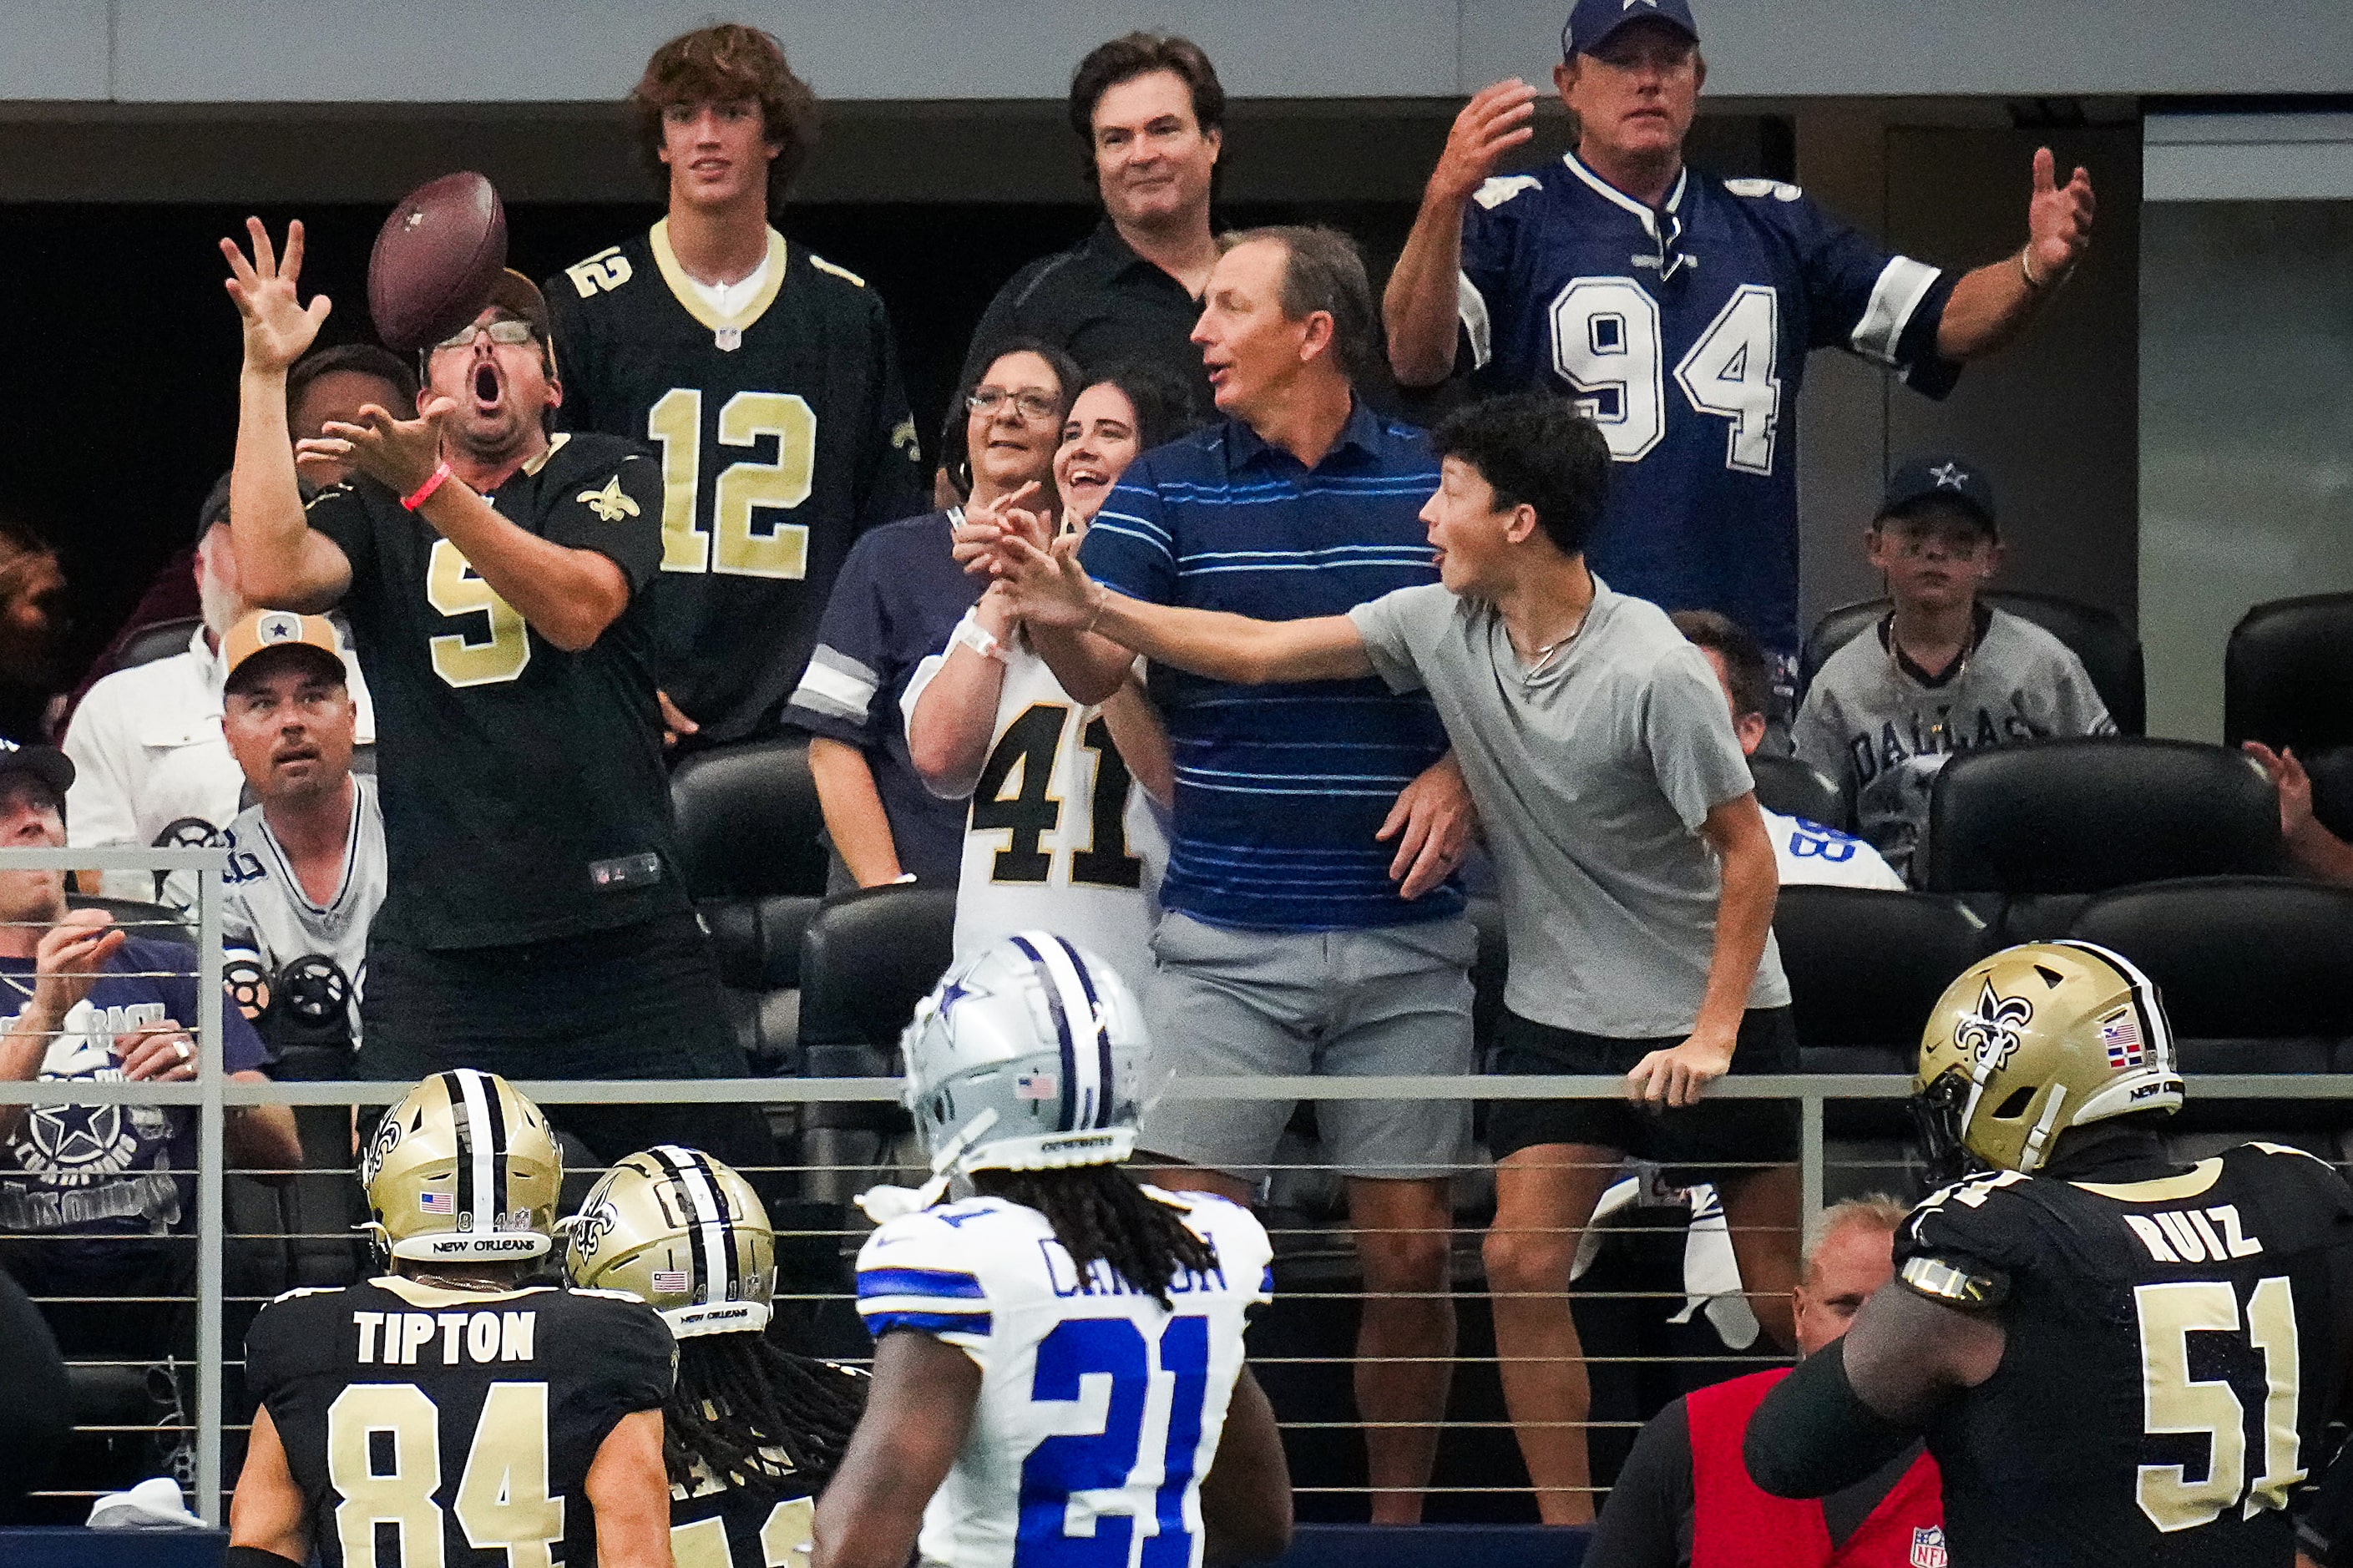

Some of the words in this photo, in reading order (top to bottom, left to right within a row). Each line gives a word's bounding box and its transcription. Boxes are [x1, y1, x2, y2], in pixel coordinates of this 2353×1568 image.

[1551, 276, 1780, 476] 94
[648, 387, 817, 581] 12
[970, 701, 1141, 888] 41
[433, 1241, 468, 1253] NEW
[473, 1240, 535, 1252] ORLEANS
[2123, 1205, 2263, 1263] RUIZ
[352, 1310, 536, 1365] TIPTON
[2133, 1276, 2308, 1533] 51
[327, 1382, 565, 1568] 84
[1015, 1314, 1211, 1568] 21
[1917, 1545, 1947, 1567] NFL
